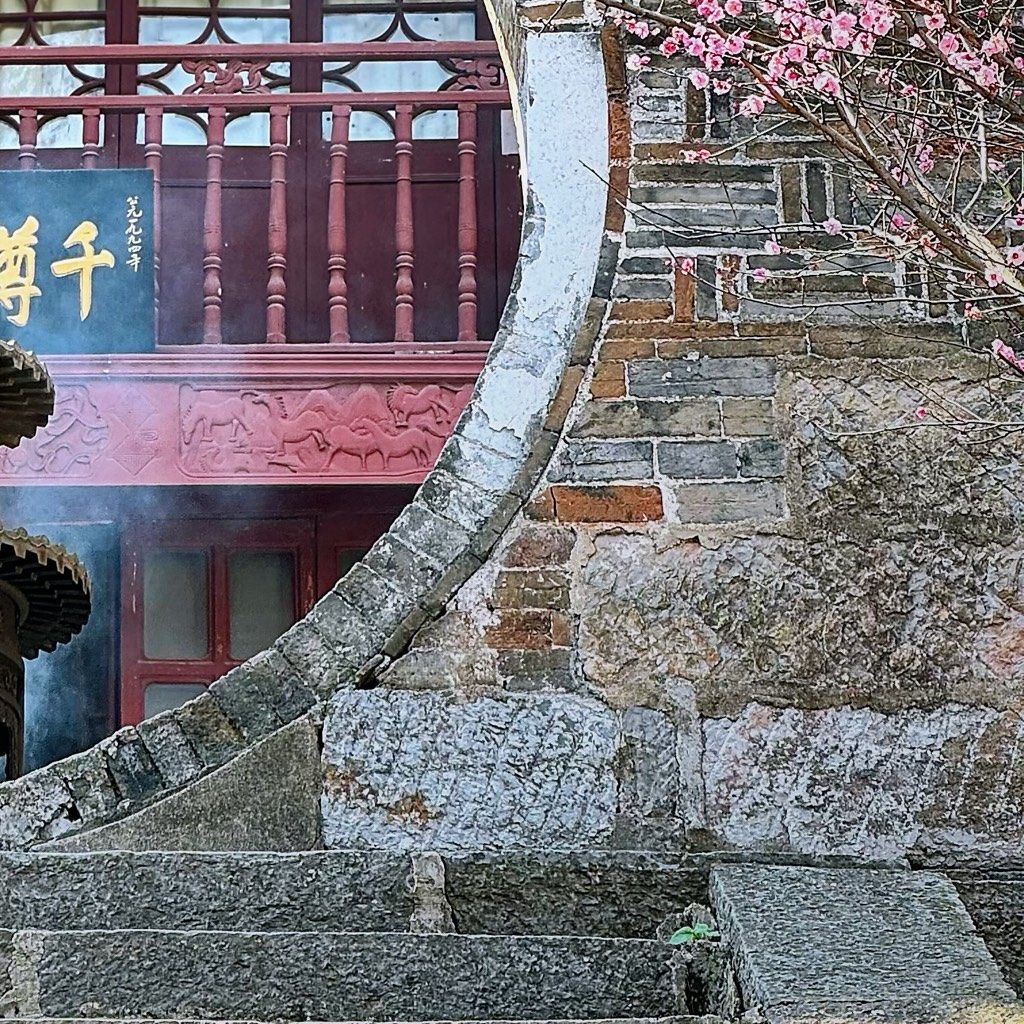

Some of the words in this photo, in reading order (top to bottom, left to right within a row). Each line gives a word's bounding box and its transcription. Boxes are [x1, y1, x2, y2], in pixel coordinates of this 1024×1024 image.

[125, 195, 143, 273] 公元一九九四年
